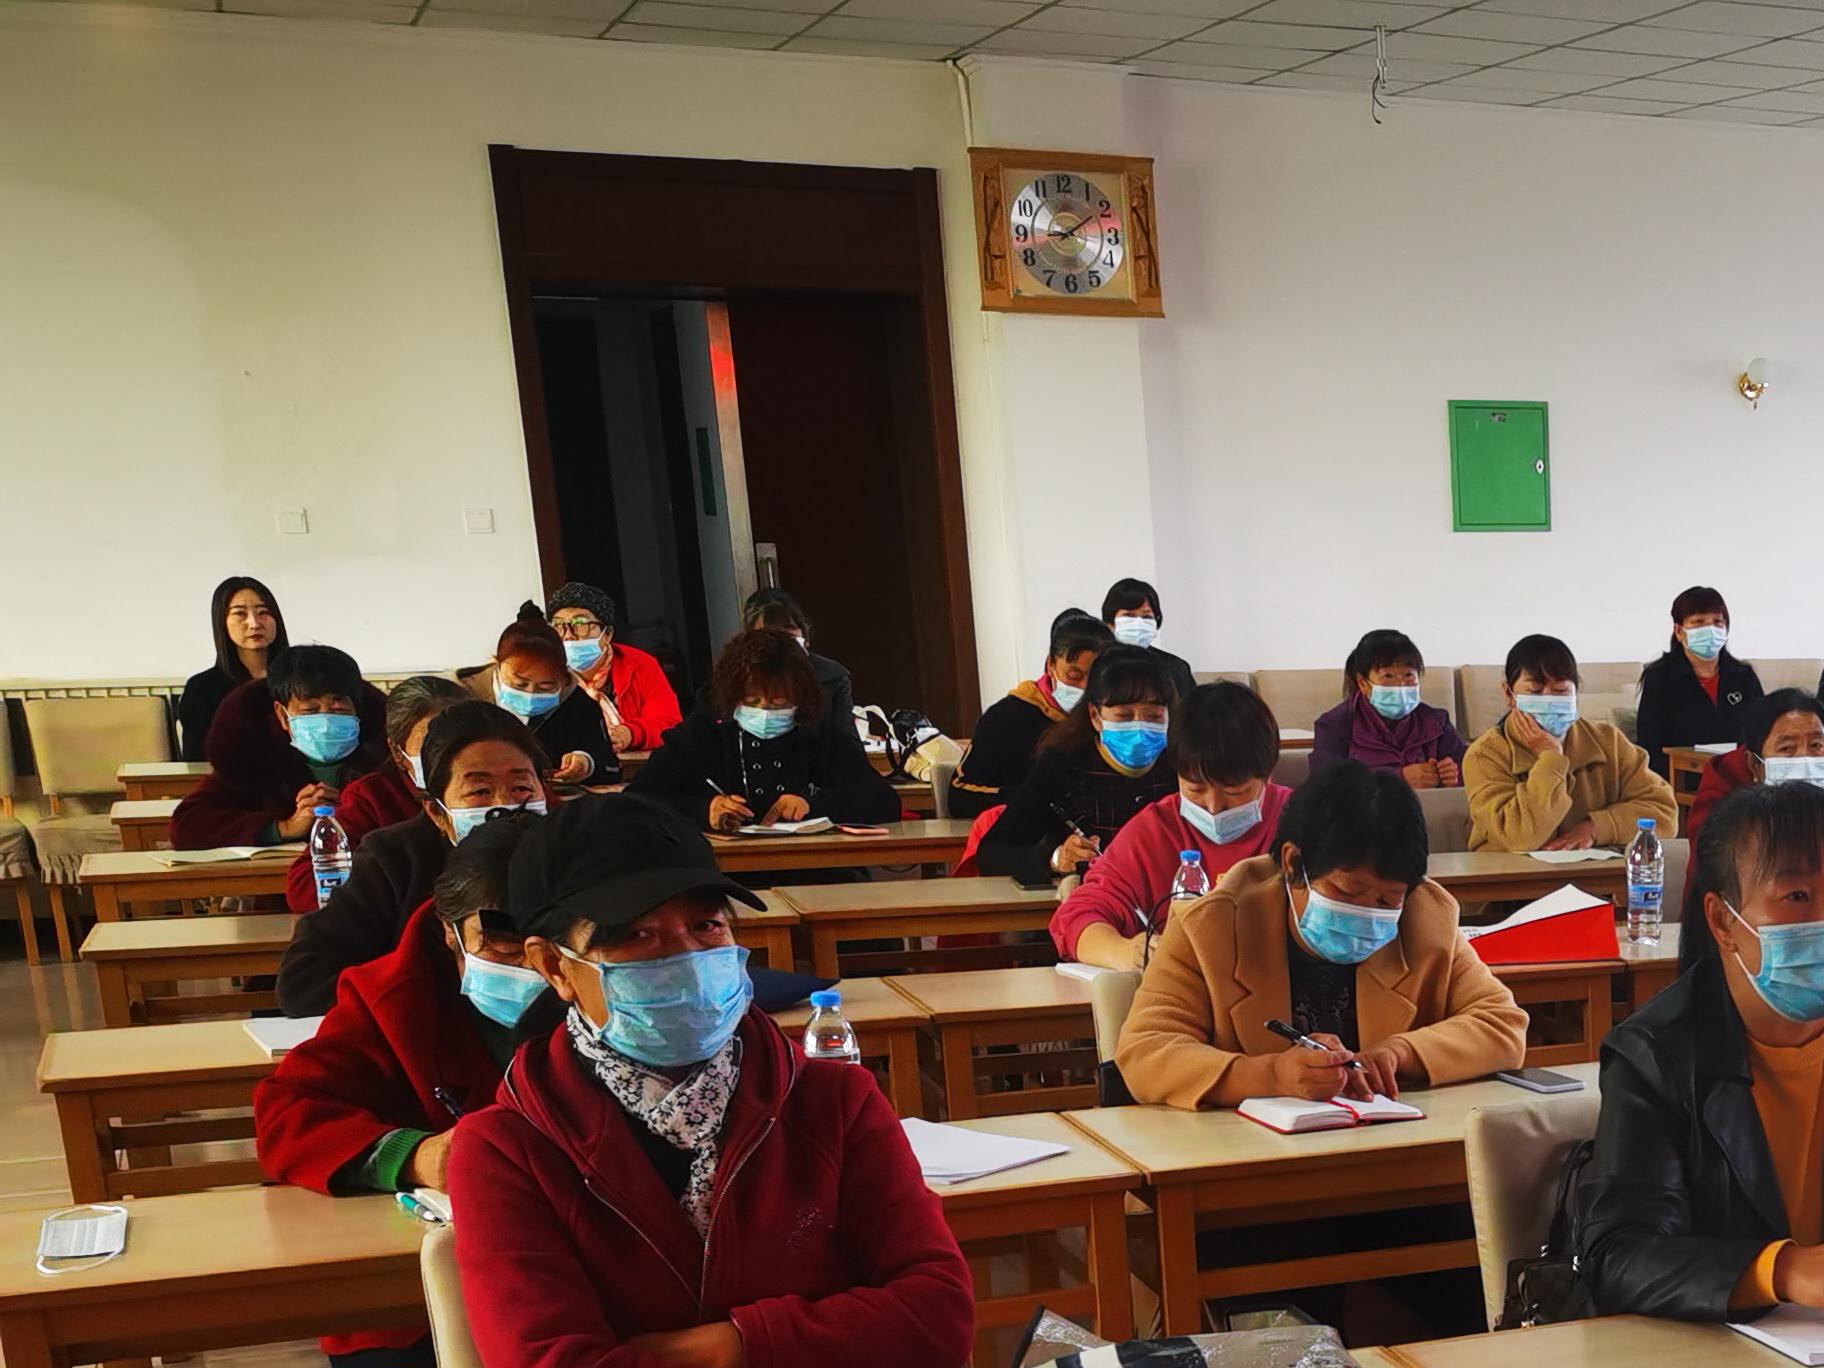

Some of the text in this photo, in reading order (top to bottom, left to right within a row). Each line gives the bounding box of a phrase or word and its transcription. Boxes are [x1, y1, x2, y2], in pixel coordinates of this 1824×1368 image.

[1034, 180, 1047, 198] 11
[1056, 174, 1072, 193] 12
[1084, 183, 1090, 201] 1
[1018, 199, 1033, 217] 10
[1099, 200, 1111, 218] 2
[1015, 225, 1028, 242] 9
[1107, 229, 1120, 246] 3
[1023, 248, 1036, 266] 8
[1103, 250, 1114, 268] 4
[1043, 270, 1057, 287] 7
[1065, 274, 1078, 293] 6
[1088, 270, 1101, 288] 5
